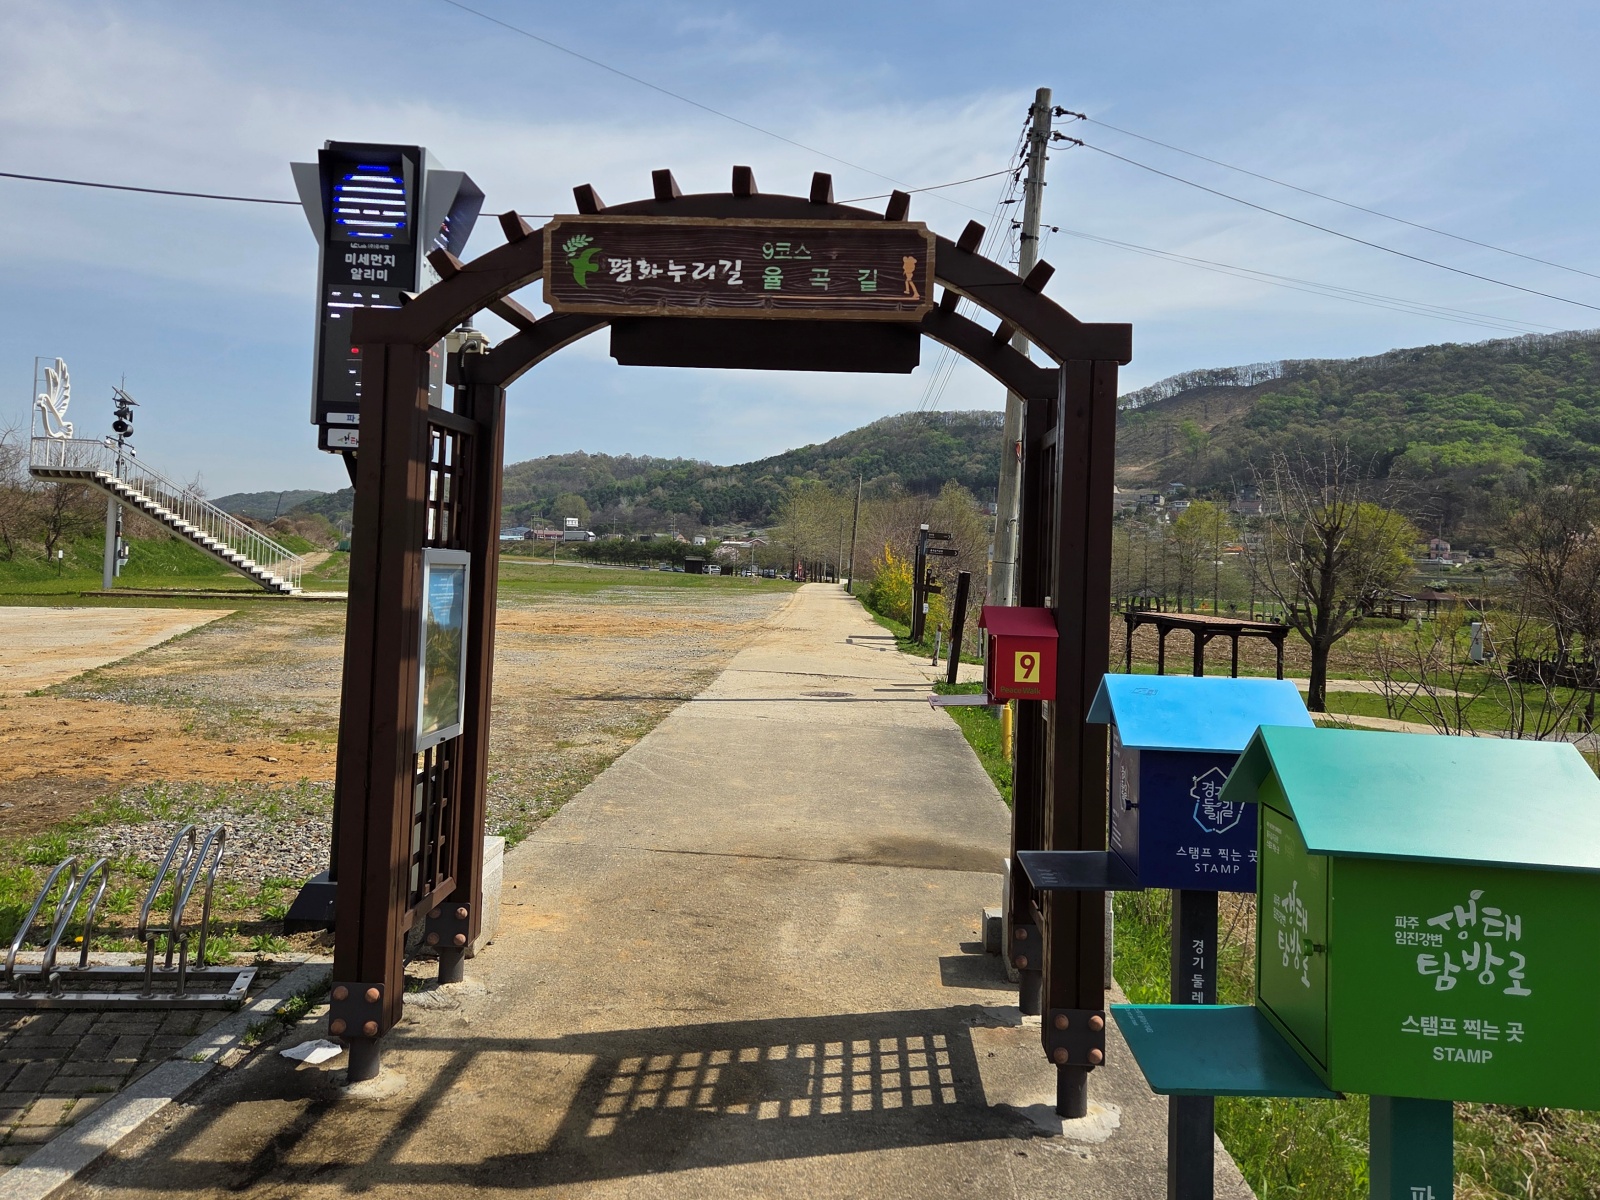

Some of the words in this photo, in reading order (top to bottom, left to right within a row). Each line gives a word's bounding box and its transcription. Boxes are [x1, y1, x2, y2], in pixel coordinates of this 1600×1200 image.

[344, 252, 396, 268] 미세먼지
[762, 242, 812, 260] 9코스
[350, 267, 388, 282] 알리미
[607, 257, 744, 285] 평화누리길
[1019, 654, 1036, 680] 9
[1000, 685, 1022, 694] Peace
[1022, 687, 1041, 695] Walk
[1176, 846, 1212, 860] 스탬프
[1218, 848, 1242, 862] 찍는
[1247, 849, 1258, 863] 곳
[1194, 863, 1240, 874] STAMP
[1394, 915, 1420, 930] 파주
[1426, 898, 1522, 942] 생태
[1394, 930, 1443, 948] 임진강변
[1416, 940, 1532, 997] 탐방로
[1401, 1015, 1458, 1037] 스탬프
[1463, 1019, 1501, 1041] 찍는
[1505, 1021, 1525, 1043] 곳
[1432, 1046, 1493, 1064] STAMP
